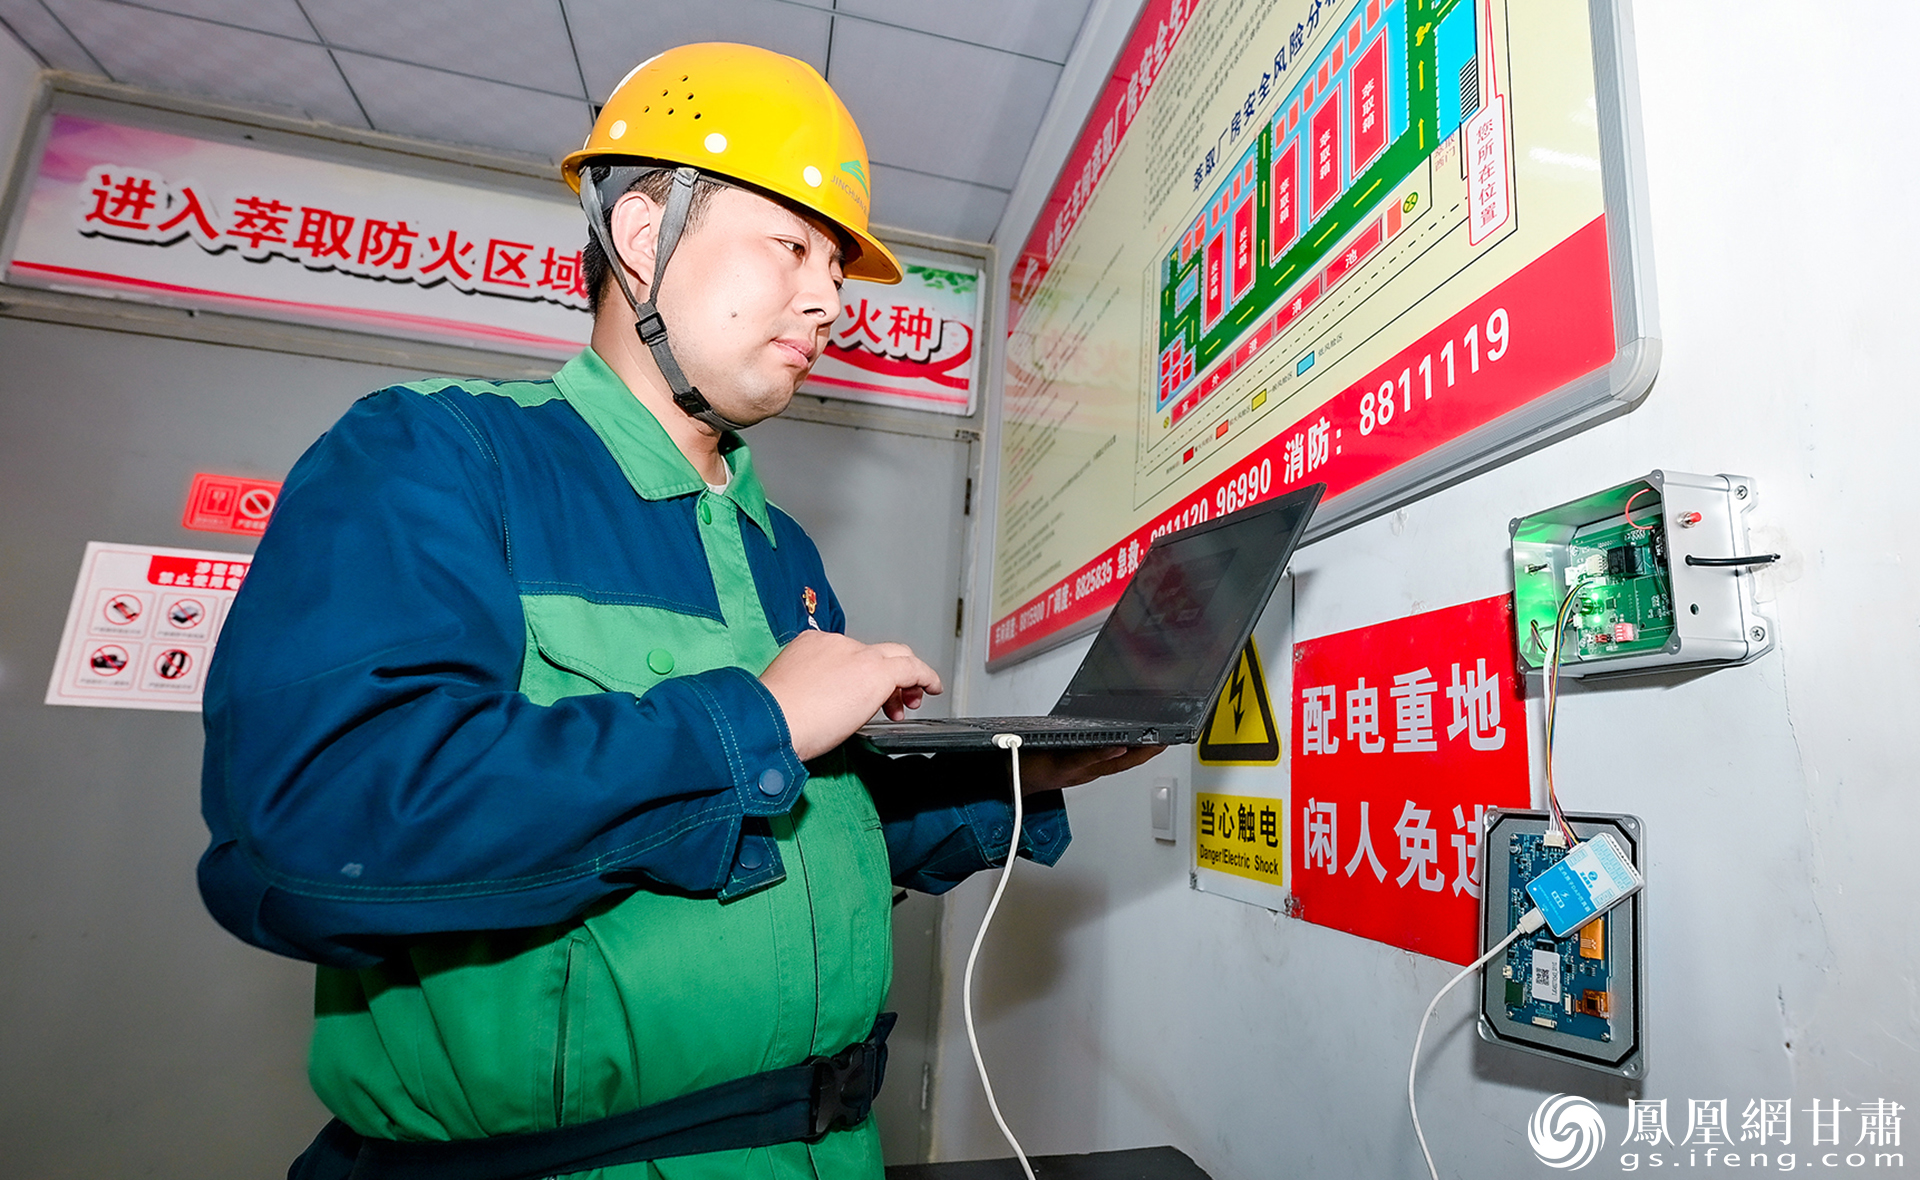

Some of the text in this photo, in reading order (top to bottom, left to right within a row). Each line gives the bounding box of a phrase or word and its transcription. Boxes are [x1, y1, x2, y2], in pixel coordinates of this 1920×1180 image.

[1192, 0, 1336, 192] 萃取厂房安全风险分
[1476, 118, 1498, 228] 您所在位置
[84, 173, 588, 299] 进入萃取防火区域
[838, 298, 933, 352] 火种
[1344, 248, 1358, 267] 池
[1216, 458, 1271, 518] 96990
[1359, 307, 1510, 436] 8811119
[1302, 658, 1506, 756] 配电重地
[1201, 800, 1279, 849] 当心触电
[1254, 854, 1279, 876] Shock
